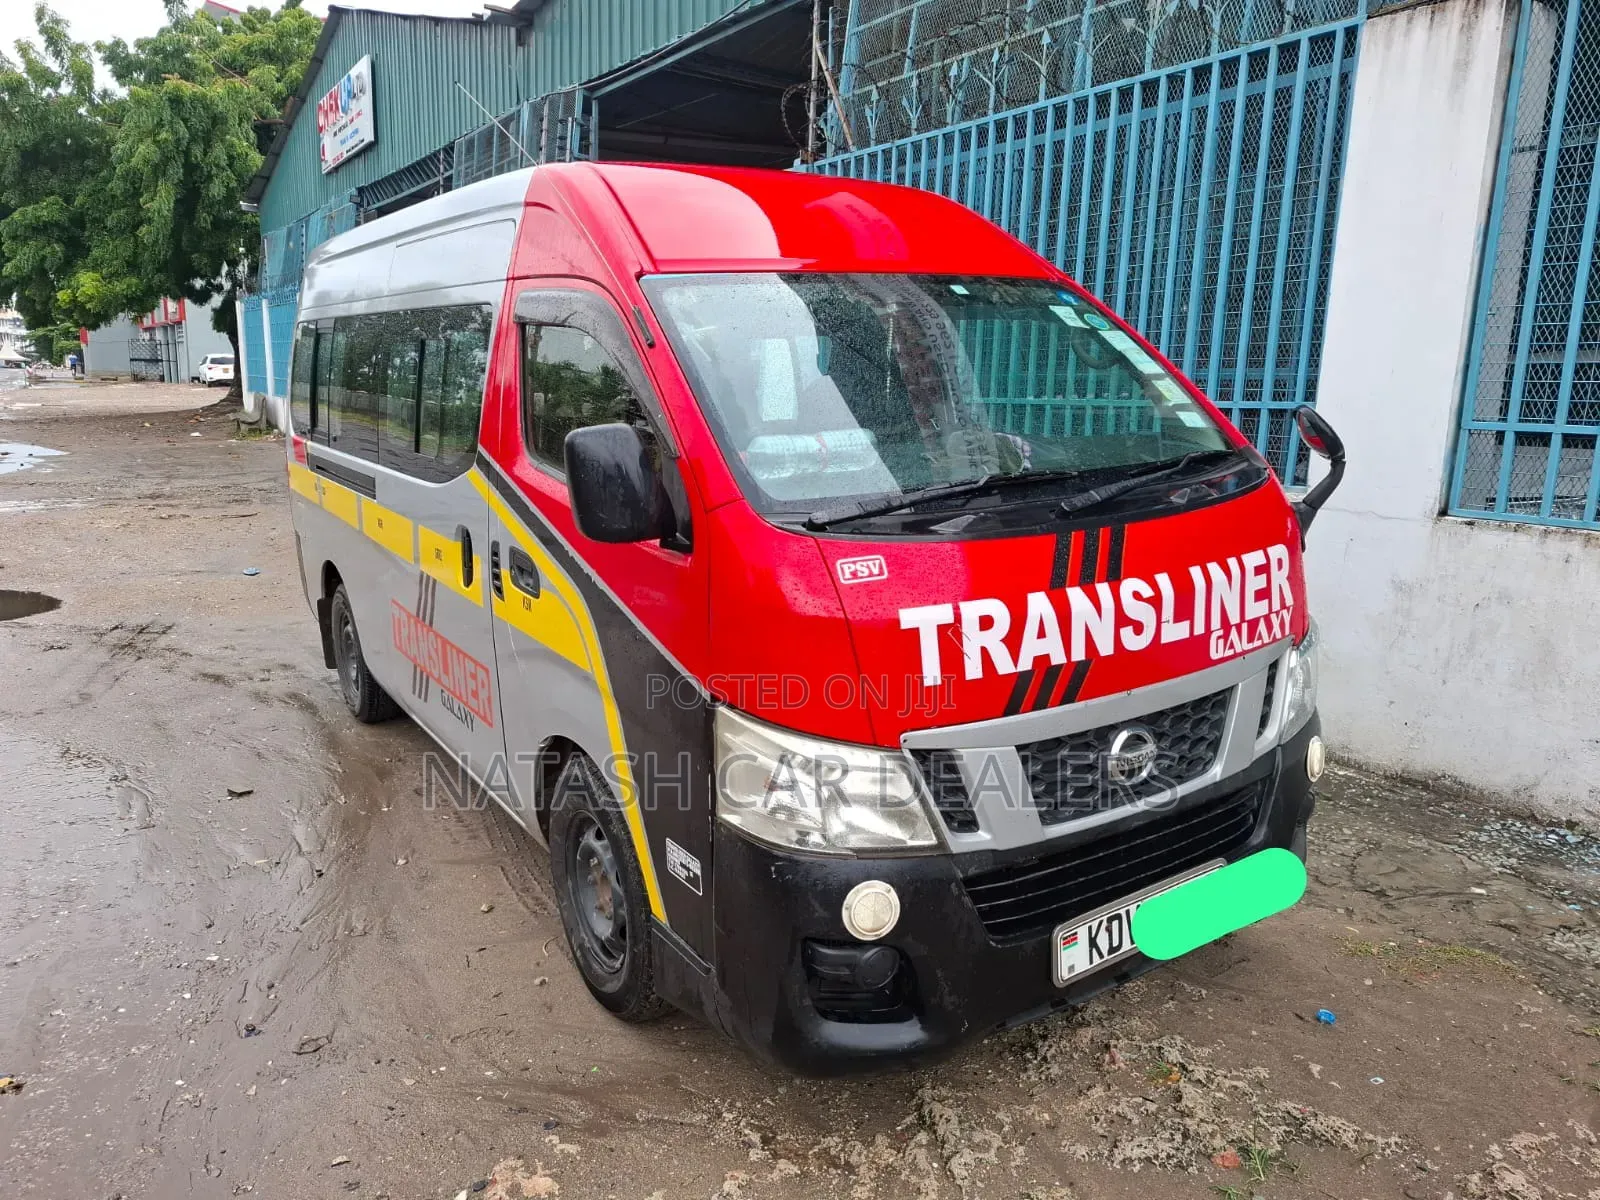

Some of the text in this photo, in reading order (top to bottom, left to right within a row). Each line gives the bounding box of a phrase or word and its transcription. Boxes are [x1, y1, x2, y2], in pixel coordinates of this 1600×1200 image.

[840, 559, 881, 579] PSV
[899, 543, 1294, 687] TRANSLINER
[1209, 606, 1293, 661] GALAXY
[391, 604, 492, 728] TRANSLINER
[440, 688, 476, 732] GALAXY
